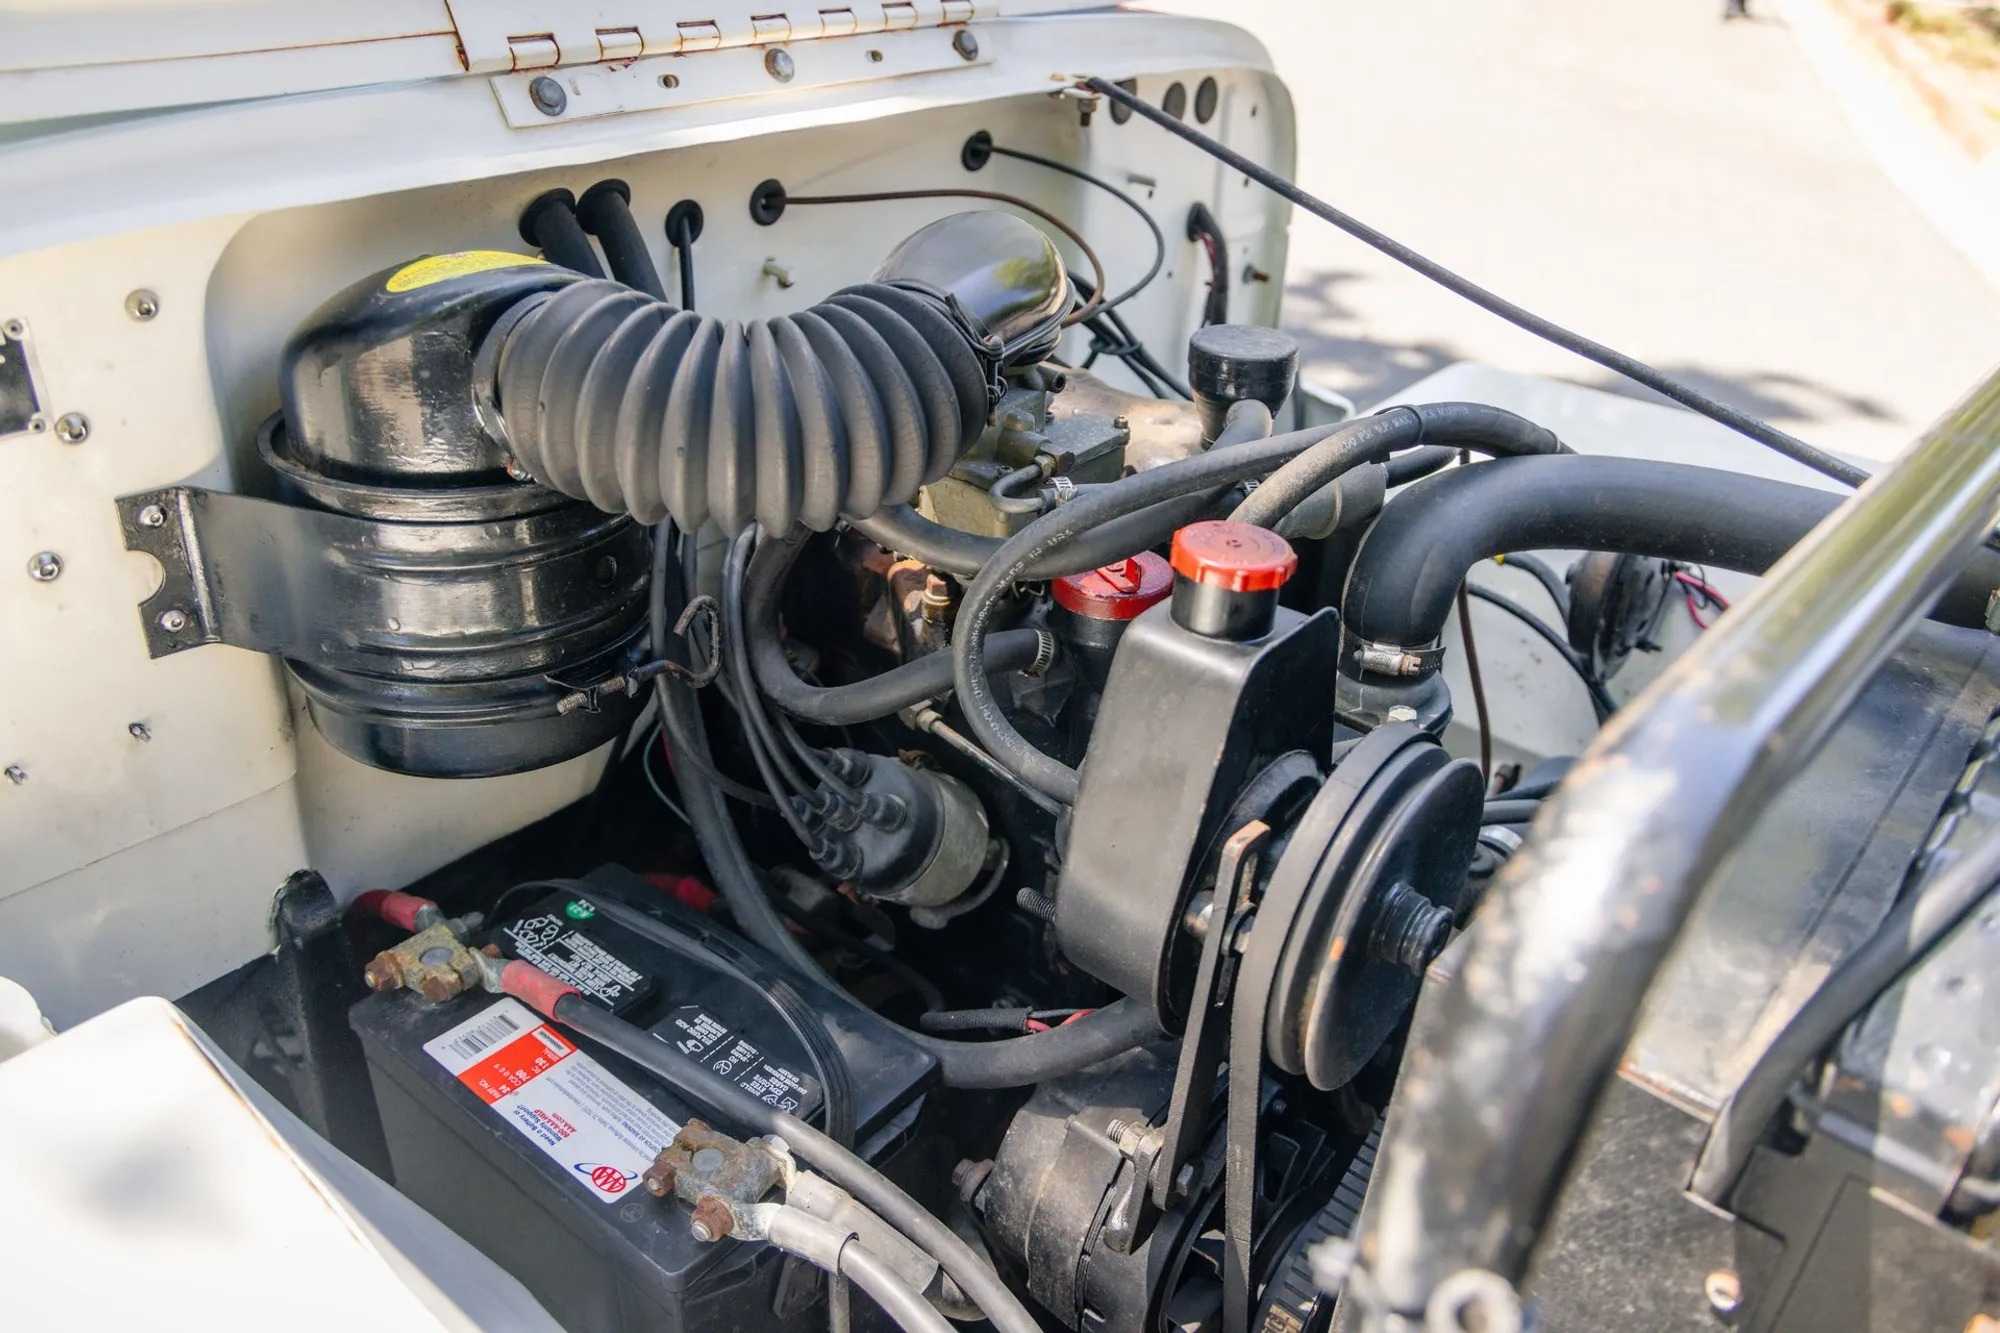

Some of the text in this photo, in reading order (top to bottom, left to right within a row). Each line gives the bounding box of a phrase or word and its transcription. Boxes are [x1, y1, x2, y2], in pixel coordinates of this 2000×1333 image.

[675, 1019, 689, 1029] ACID
[543, 1047, 559, 1061] SERIAL
[728, 1056, 738, 1064] NO
[531, 1065, 541, 1074] RC
[535, 1057, 549, 1069] 130
[508, 1074, 521, 1086] CCA
[515, 1069, 530, 1081] 700
[750, 1081, 766, 1092] EYES
[753, 1074, 783, 1096] EXPLOSIVE
[769, 1077, 789, 1091] GASES
[487, 1087, 501, 1098] PART
[517, 1105, 562, 1142] Warranty Support?
[519, 1114, 538, 1131] Battery
[534, 1109, 570, 1137] 800-AAA-HELP
[552, 1113, 576, 1133] AAA.com
[540, 1133, 555, 1146] Need
[592, 1166, 627, 1193] AAA
